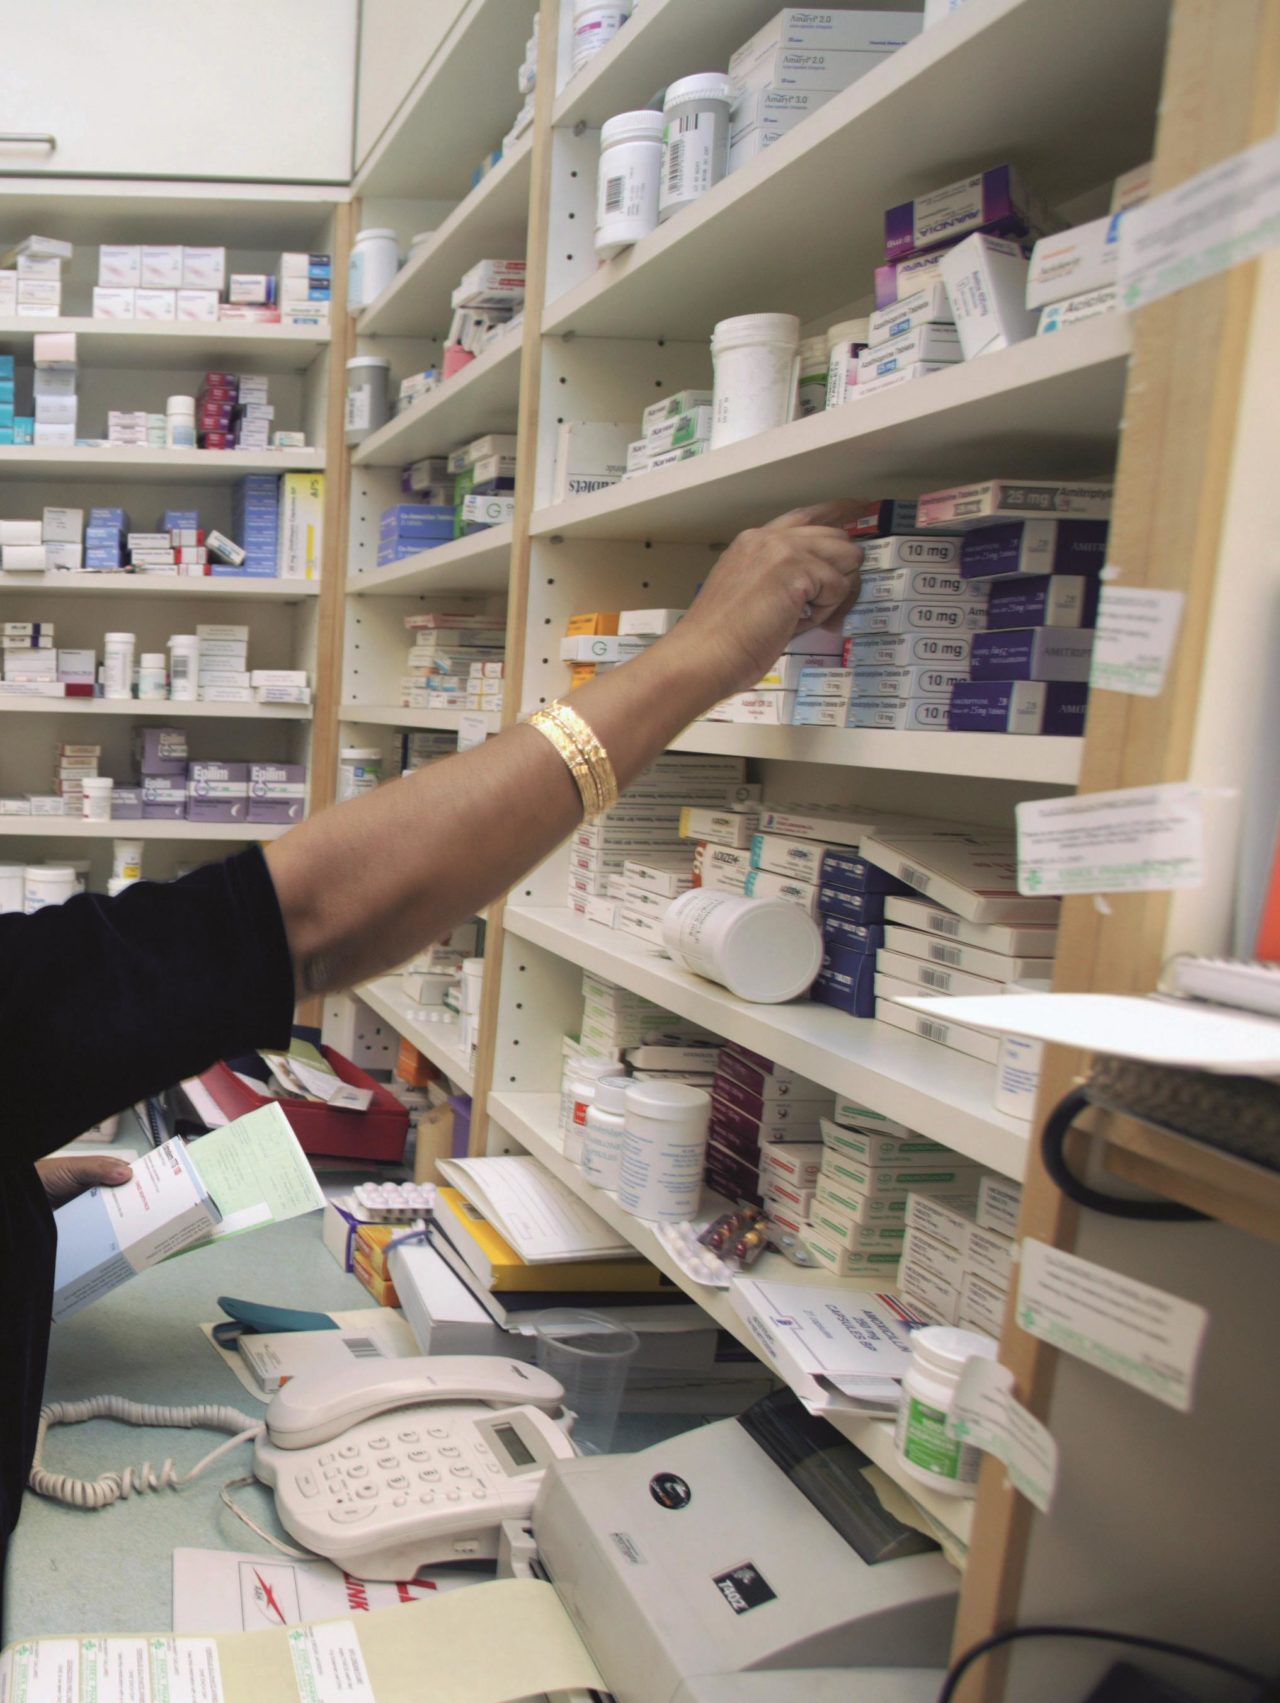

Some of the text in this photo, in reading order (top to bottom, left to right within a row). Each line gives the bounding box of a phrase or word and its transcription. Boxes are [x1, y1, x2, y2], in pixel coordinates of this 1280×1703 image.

[568, 476, 617, 495] ablets
[1007, 490, 1049, 506] 25 mg
[908, 545, 949, 559] 10 mg
[921, 577, 961, 591] 10 mg
[918, 609, 958, 624] 10 mg
[922, 642, 962, 657] 10 mg
[927, 675, 942, 686] 10
[924, 707, 939, 718] 10
[194, 766, 229, 782] Epilim
[251, 767, 287, 782] Epilim
[144, 778, 171, 790] Epilim
